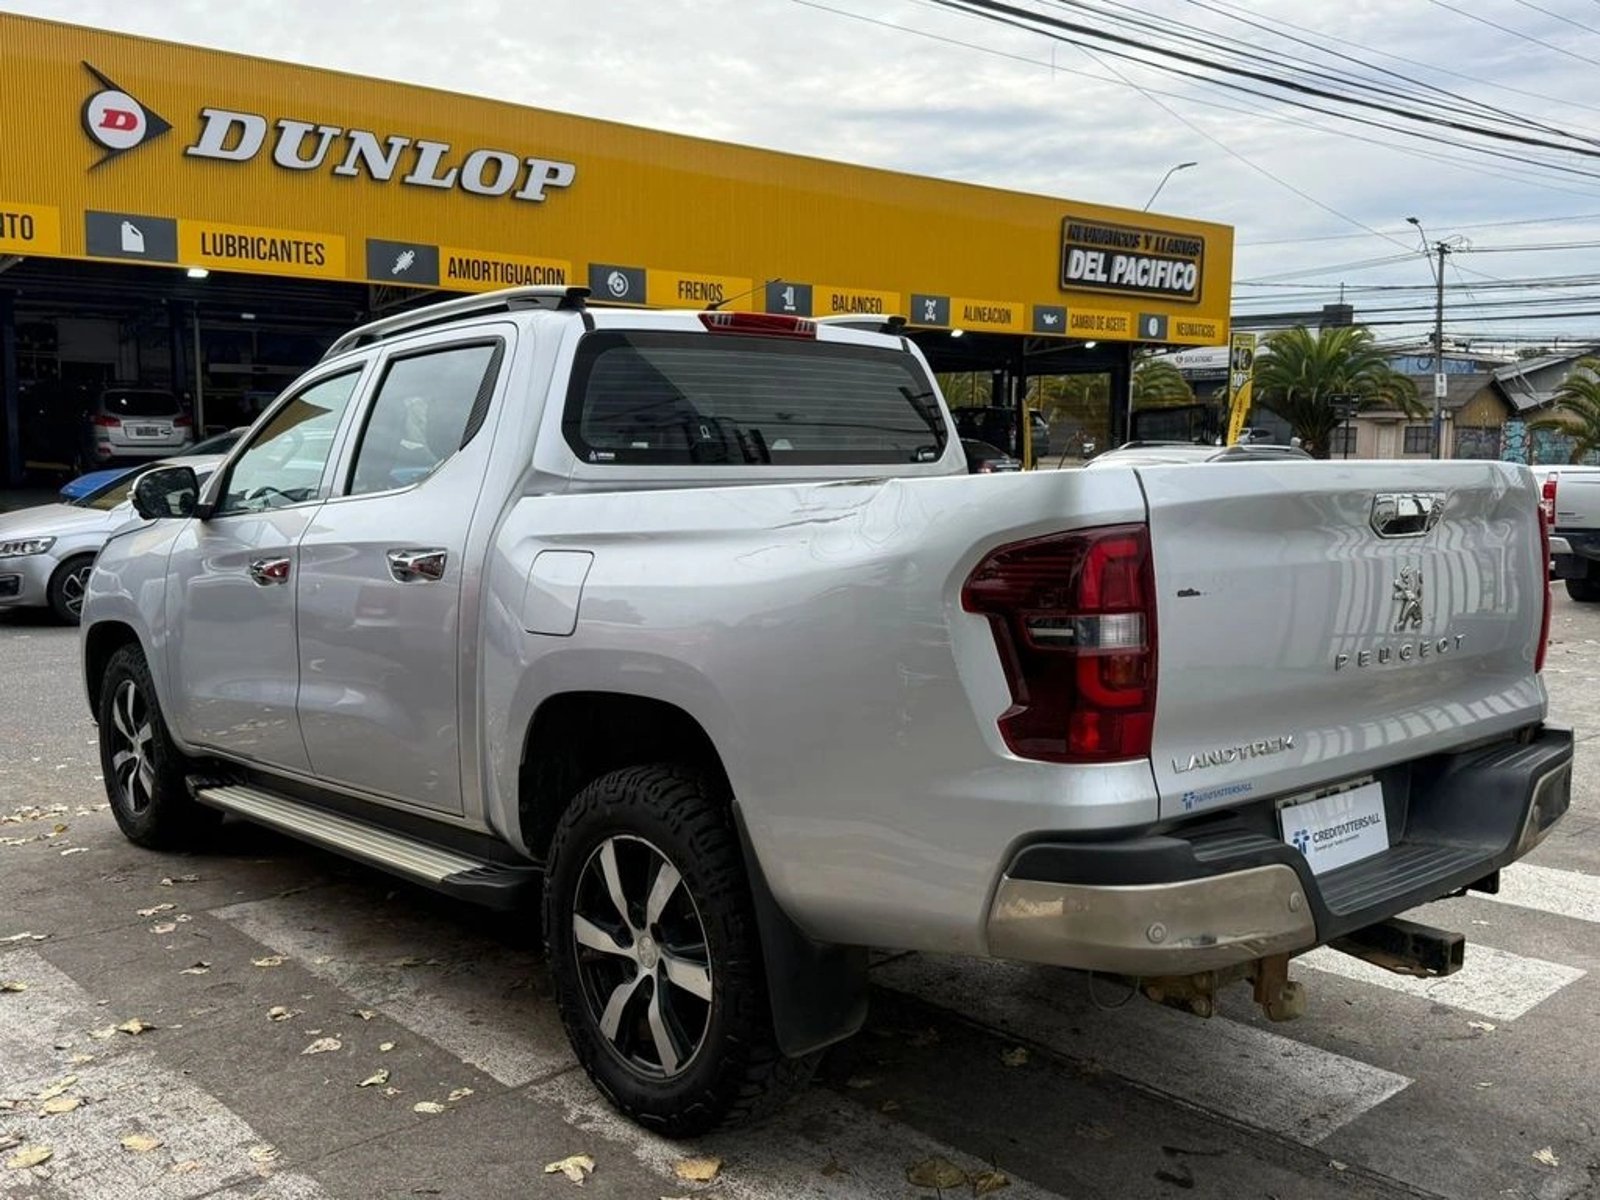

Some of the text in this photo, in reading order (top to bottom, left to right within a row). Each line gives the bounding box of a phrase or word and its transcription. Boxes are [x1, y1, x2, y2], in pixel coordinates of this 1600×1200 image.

[99, 108, 138, 131] D
[186, 108, 576, 201] DUNLOP
[201, 231, 325, 266] LUBRICANTES
[1144, 232, 1153, 251] Y
[448, 256, 565, 285] AMORTIGUACION
[1067, 249, 1198, 291] DEL PACIFICO
[677, 280, 723, 303] FRENOS
[832, 293, 882, 314] BALANCEO
[963, 304, 1012, 325] ALINEACION
[1071, 313, 1127, 332] CAMBIO DE ACEITE
[1176, 321, 1216, 338] NEUMATICOS
[1335, 634, 1465, 671] PEUGEOT
[1172, 735, 1295, 774] LANDTREK
[1312, 813, 1382, 844] CREDITATTERSALL
